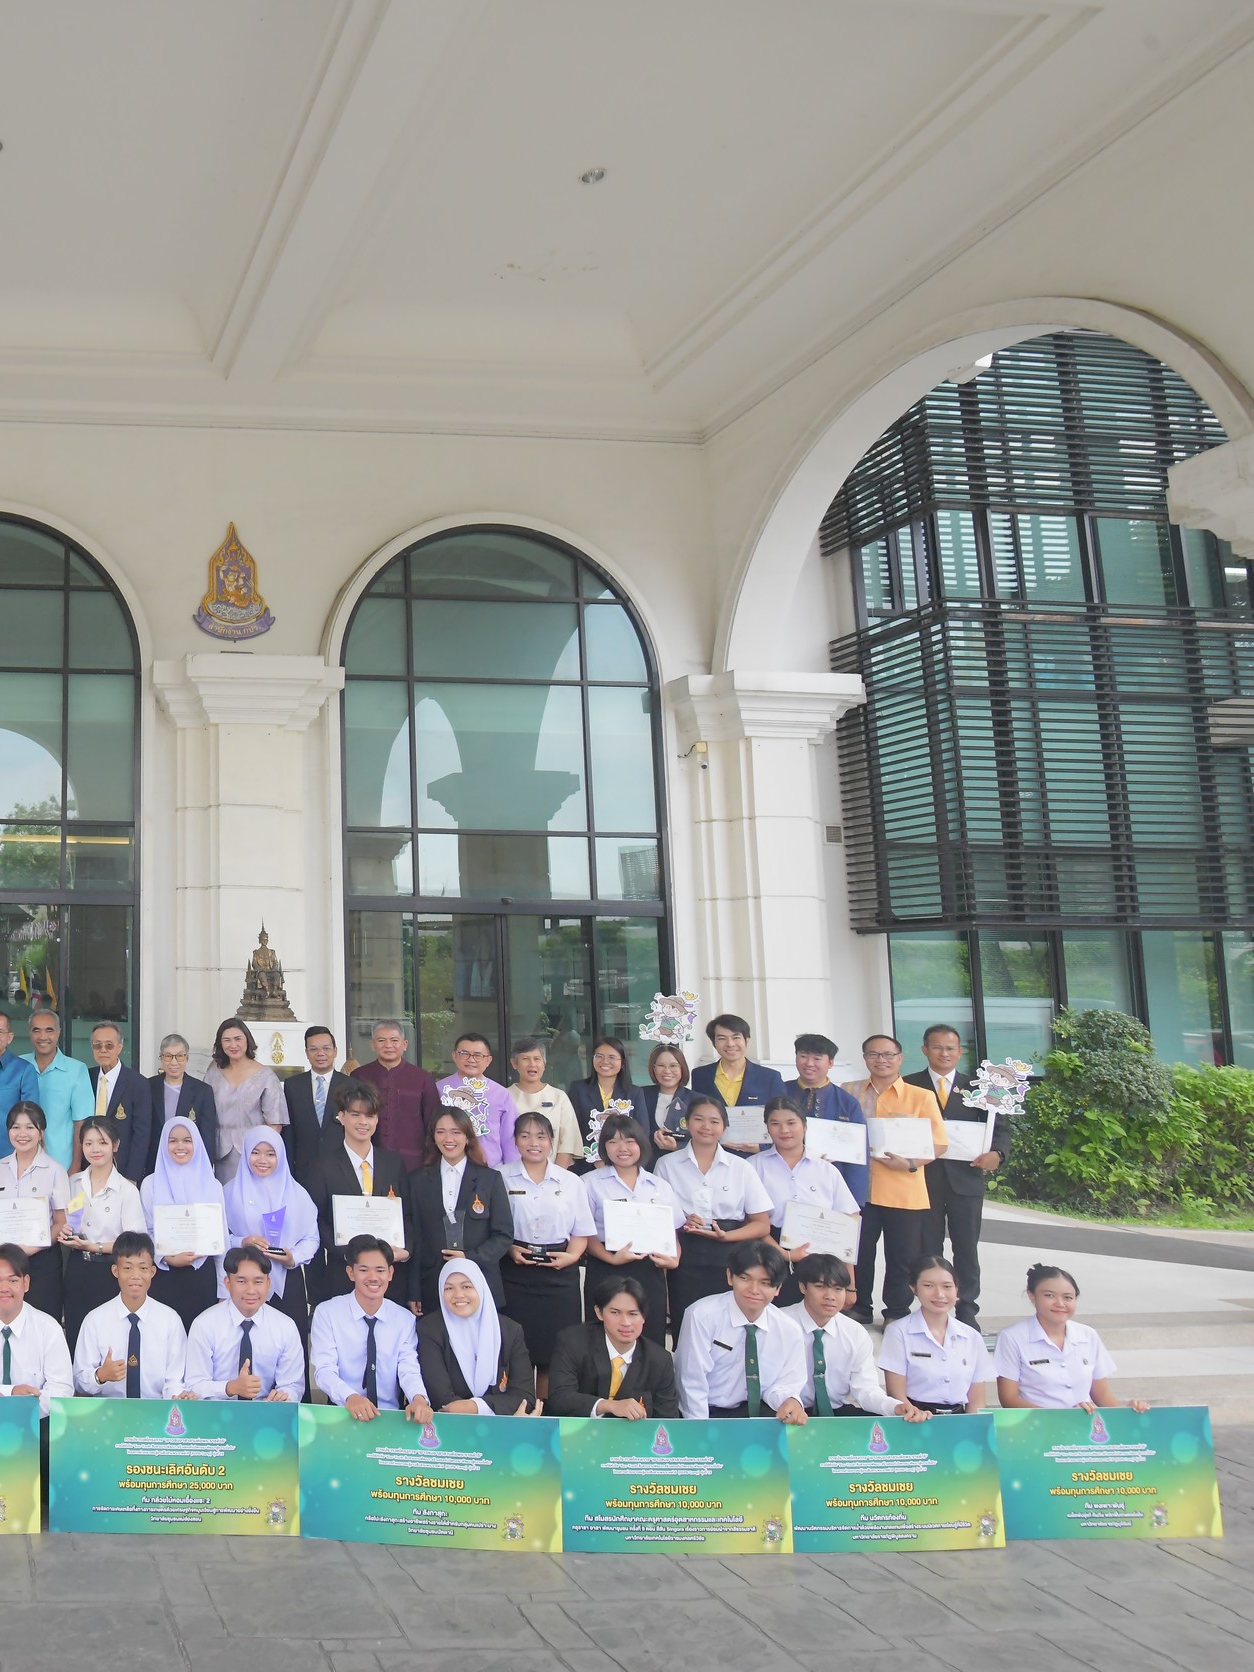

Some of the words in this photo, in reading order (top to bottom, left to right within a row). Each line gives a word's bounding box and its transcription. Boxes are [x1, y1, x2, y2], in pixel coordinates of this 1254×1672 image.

[208, 623, 242, 635] สำนักงาน
[126, 1463, 216, 1476] รองชนะเลิศอันดับ
[218, 1466, 226, 1476] 2
[1072, 1470, 1133, 1482] รางวัลชมเชย
[118, 1479, 188, 1492] พร้อมทุนการศึกษา
[189, 1481, 216, 1490] 25,000
[218, 1482, 234, 1490] บาท
[396, 1475, 464, 1489] รางวัลชมเชย
[630, 1482, 697, 1495] รางวัลชมเชย
[849, 1480, 914, 1494] รางวัลชมเชย
[370, 1489, 442, 1504] พร้อมทุนการศึกษา
[444, 1495, 472, 1506] 10,000
[473, 1496, 490, 1506] บาท
[1050, 1486, 1114, 1498] พร้อมทุนการศึกษา
[1116, 1487, 1140, 1496] 10,000
[1142, 1486, 1157, 1495] บาท
[605, 1498, 676, 1511] พร้อมทุนการศึกษา
[678, 1500, 706, 1510] 10,000
[706, 1500, 723, 1508] บาท
[826, 1498, 894, 1509] พร้อมทุนการศึกษา
[896, 1498, 922, 1507] 10,000
[923, 1498, 938, 1506] บาท
